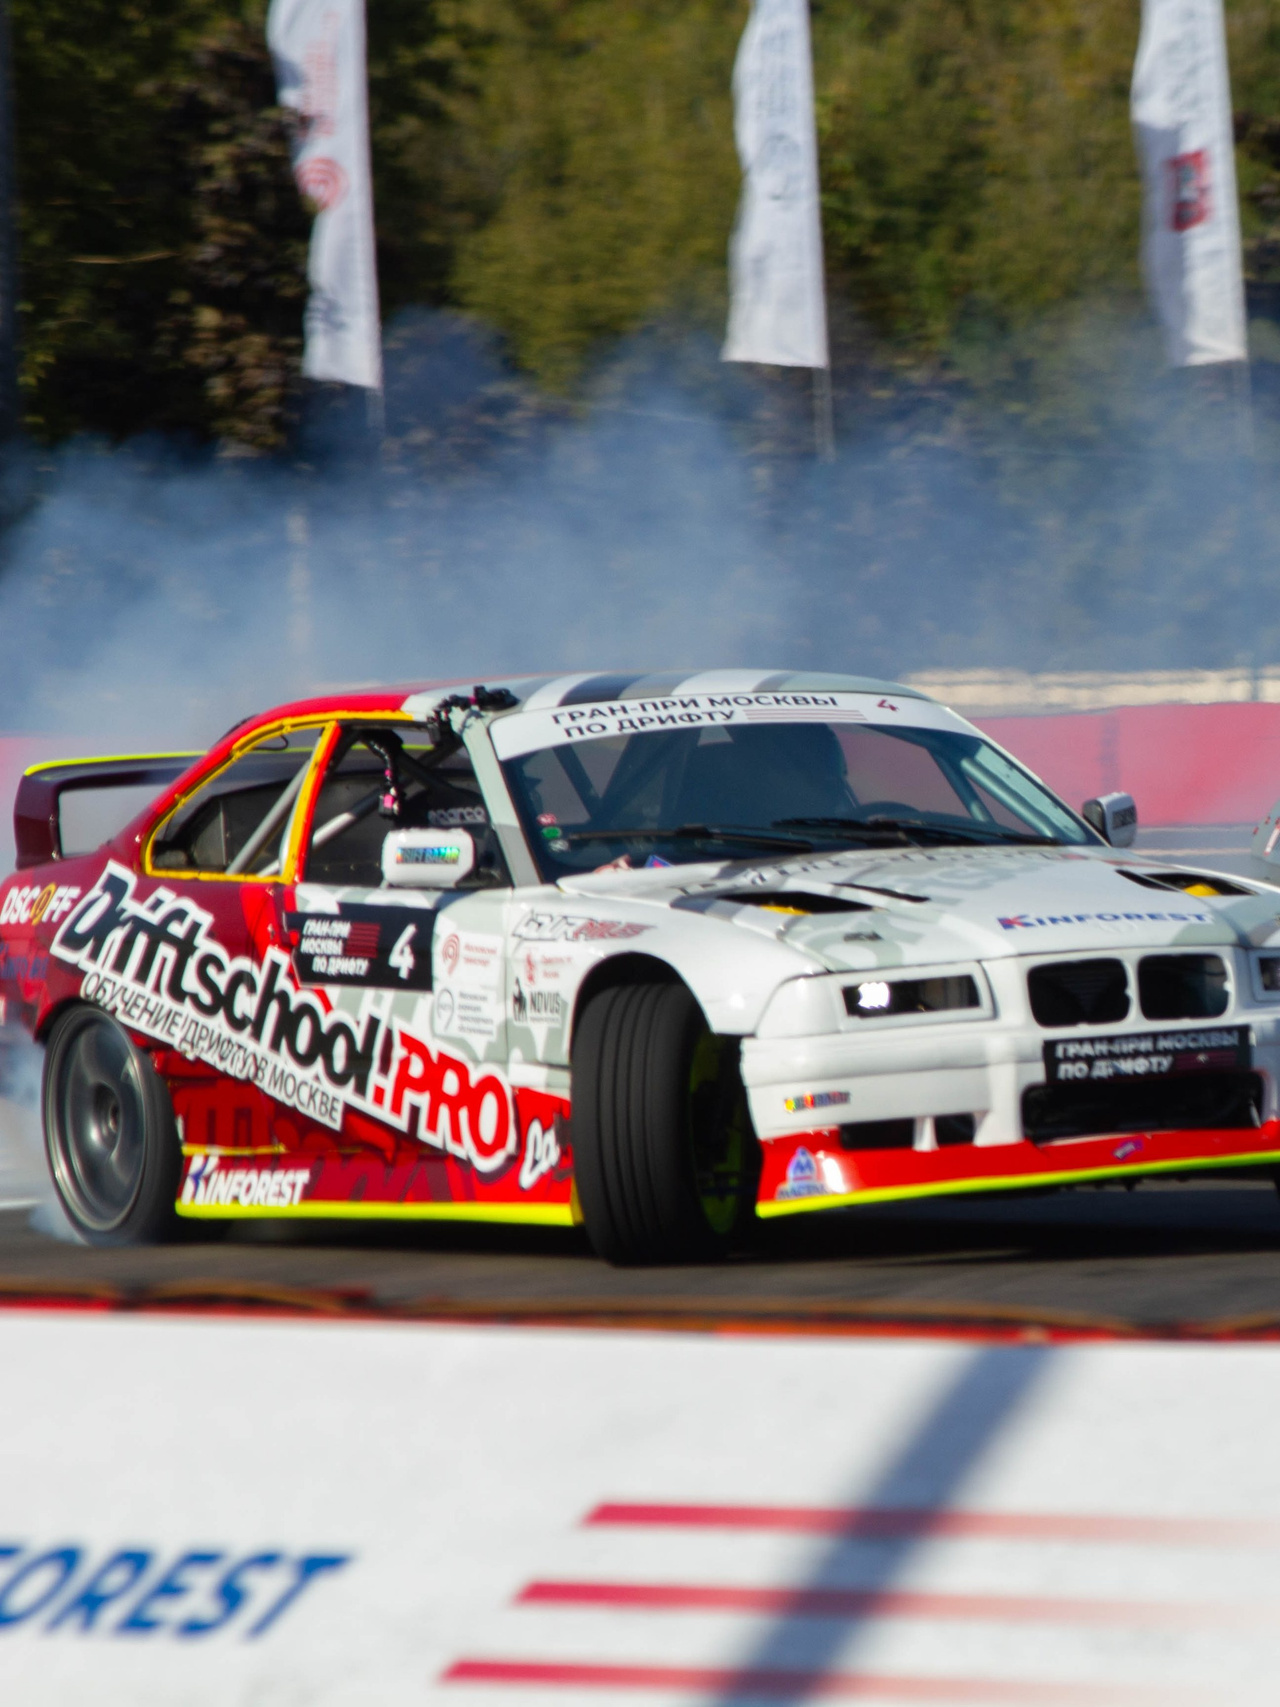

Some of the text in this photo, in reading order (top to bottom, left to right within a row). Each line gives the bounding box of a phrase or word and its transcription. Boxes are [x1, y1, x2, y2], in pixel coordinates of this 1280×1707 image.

[551, 695, 839, 725] ГРАН-ПРИ МОСКВЫ
[877, 699, 899, 711] 4
[564, 710, 734, 738] ПО ДРИФТУ
[302, 918, 352, 939] ГРАН-ПРИ
[996, 913, 1210, 930] KINFOREST
[301, 936, 344, 956] МОСКВЫ
[389, 923, 417, 980] 4
[311, 955, 370, 977] ПО ДРИФТУ
[530, 991, 561, 1014] NOVUS
[85, 971, 184, 1036] ОБУЧЕНИЕ
[268, 1064, 341, 1124] МОСКВЕ
[1055, 1030, 1239, 1059] ГРАН-ПРИ МОСКВЫ
[1057, 1060, 1089, 1080] ПО
[181, 1152, 310, 1207] KINFOREST
[0, 1546, 353, 1639] OREST
